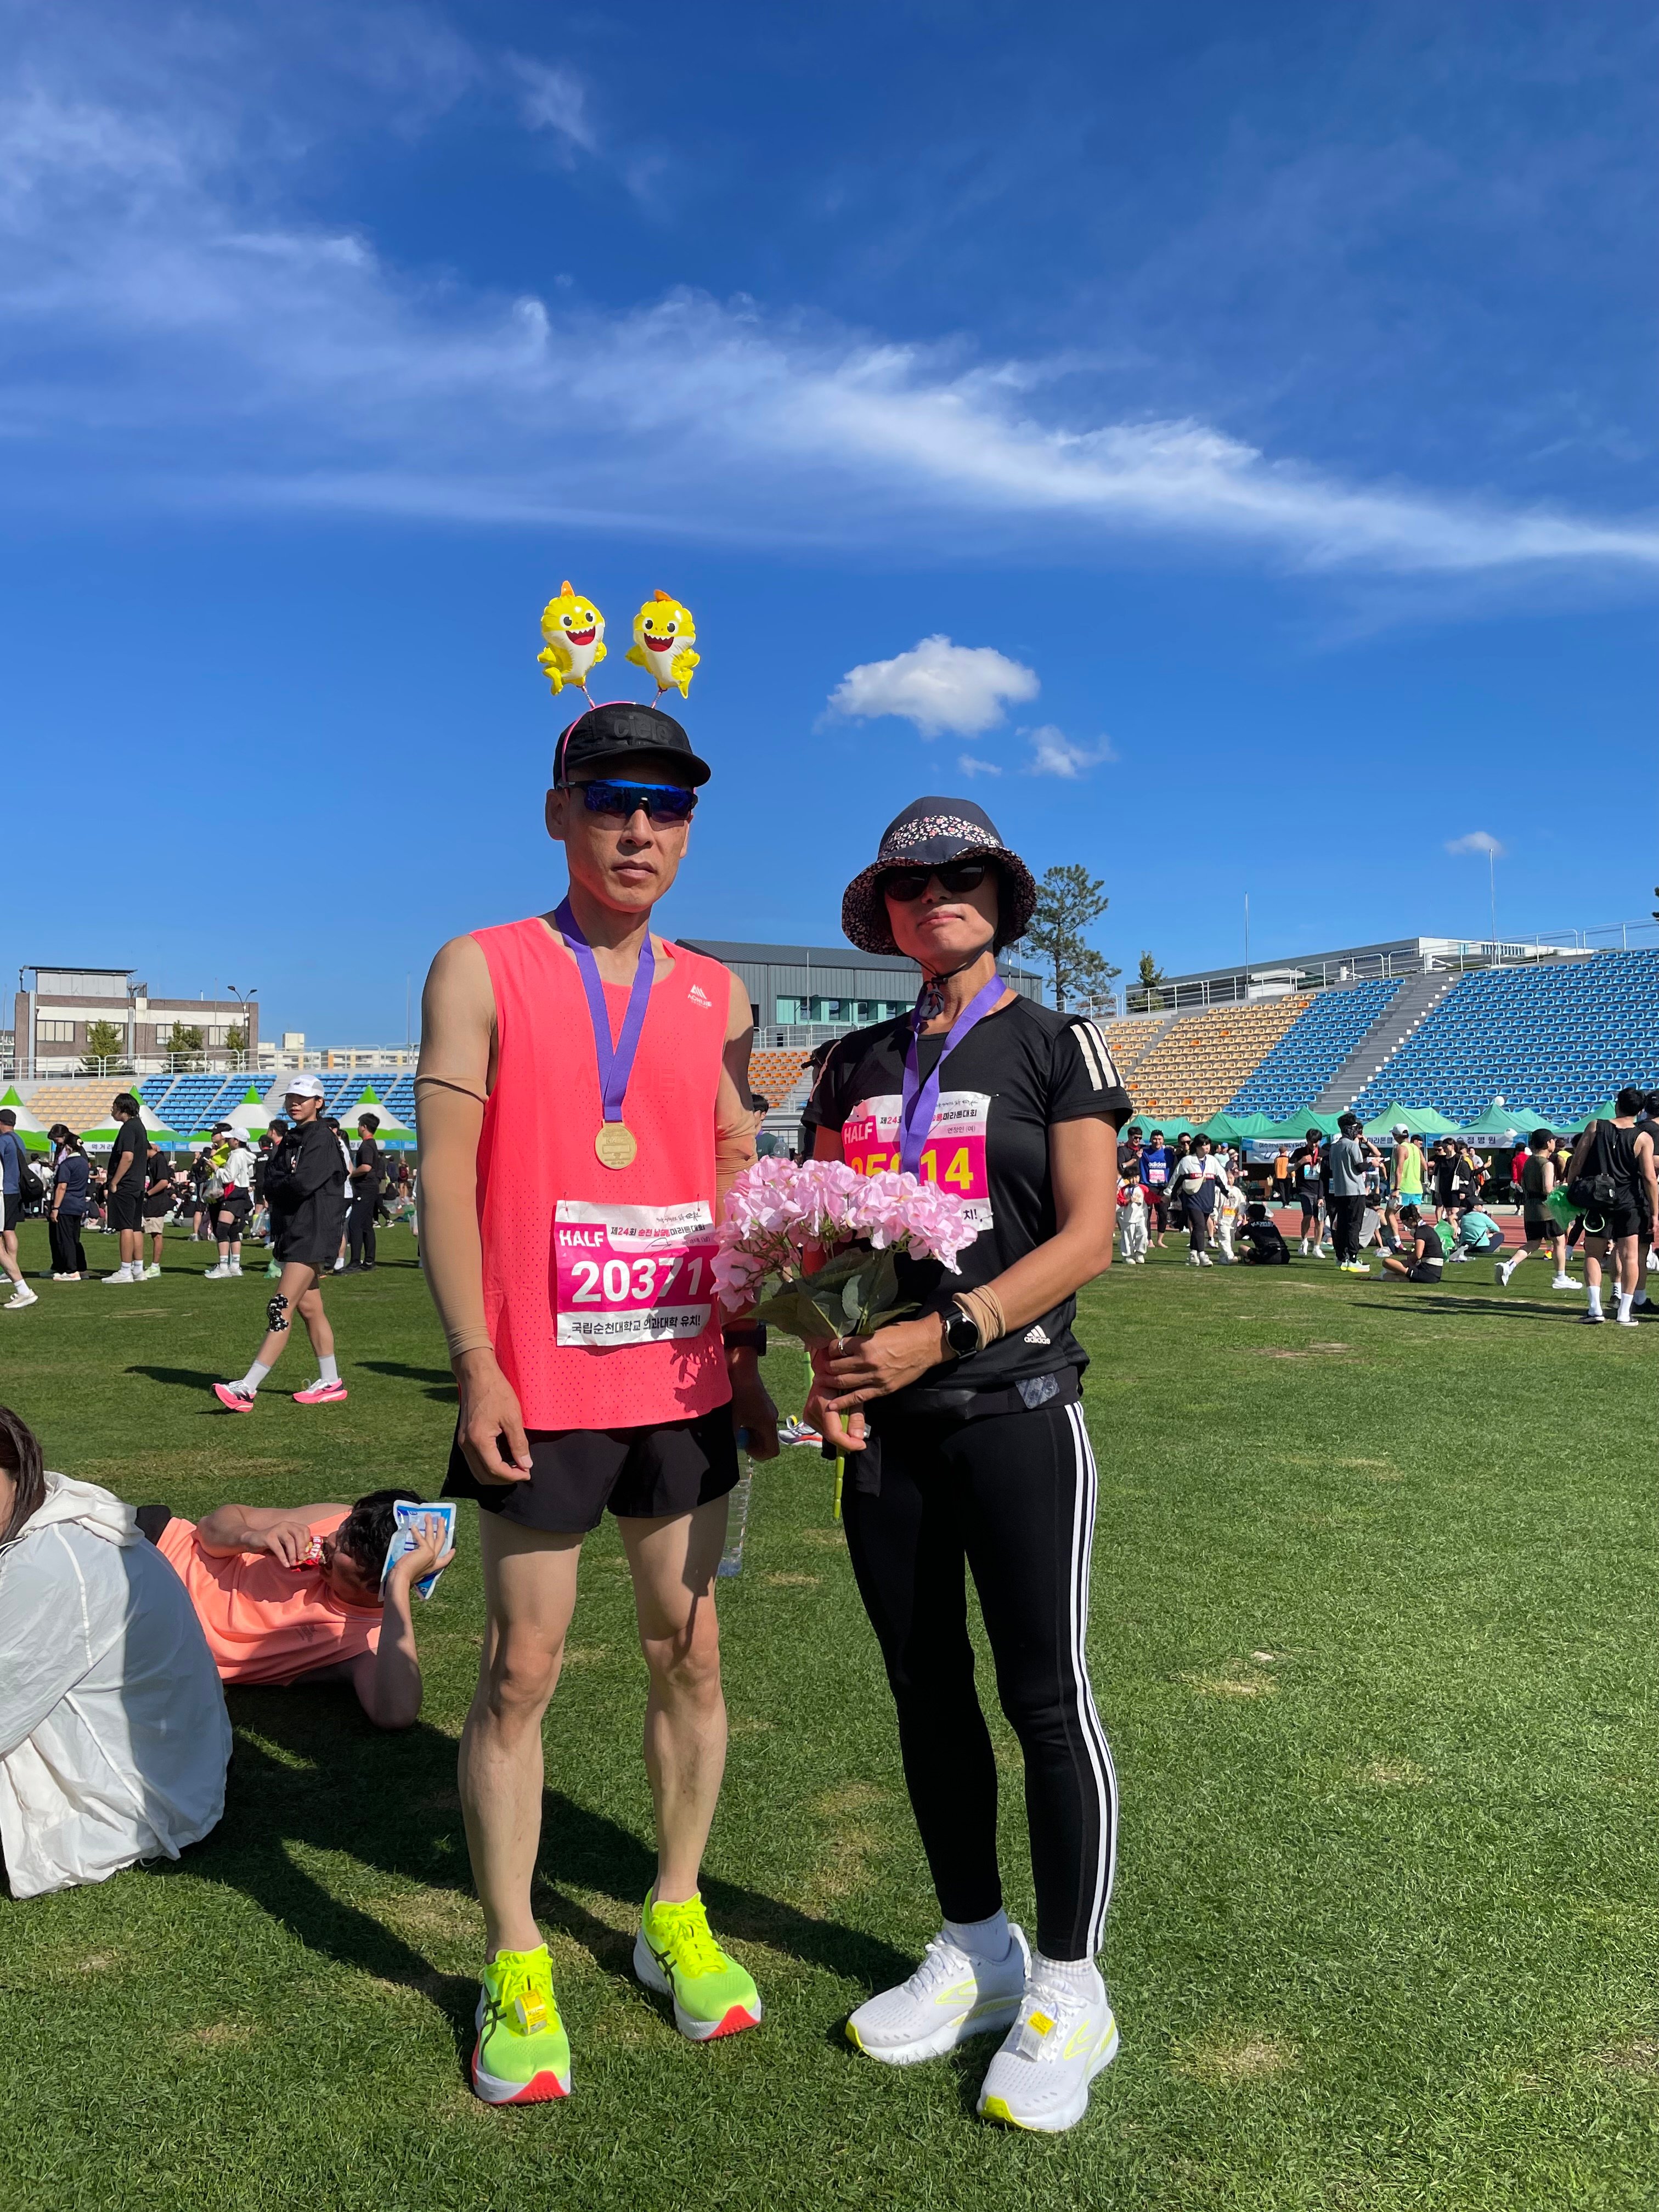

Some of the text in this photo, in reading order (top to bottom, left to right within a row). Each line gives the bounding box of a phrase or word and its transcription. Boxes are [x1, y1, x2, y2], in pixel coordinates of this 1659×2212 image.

[844, 1122, 873, 1145] HALF
[963, 1209, 978, 1220] 치!
[559, 1229, 605, 1247] HALF
[611, 1227, 636, 1235] 제24회
[571, 1257, 702, 1303] 20371
[572, 1314, 701, 1335] 국립순천대학교 의과대학 유치!
[1024, 1336, 1051, 1345] adidas
